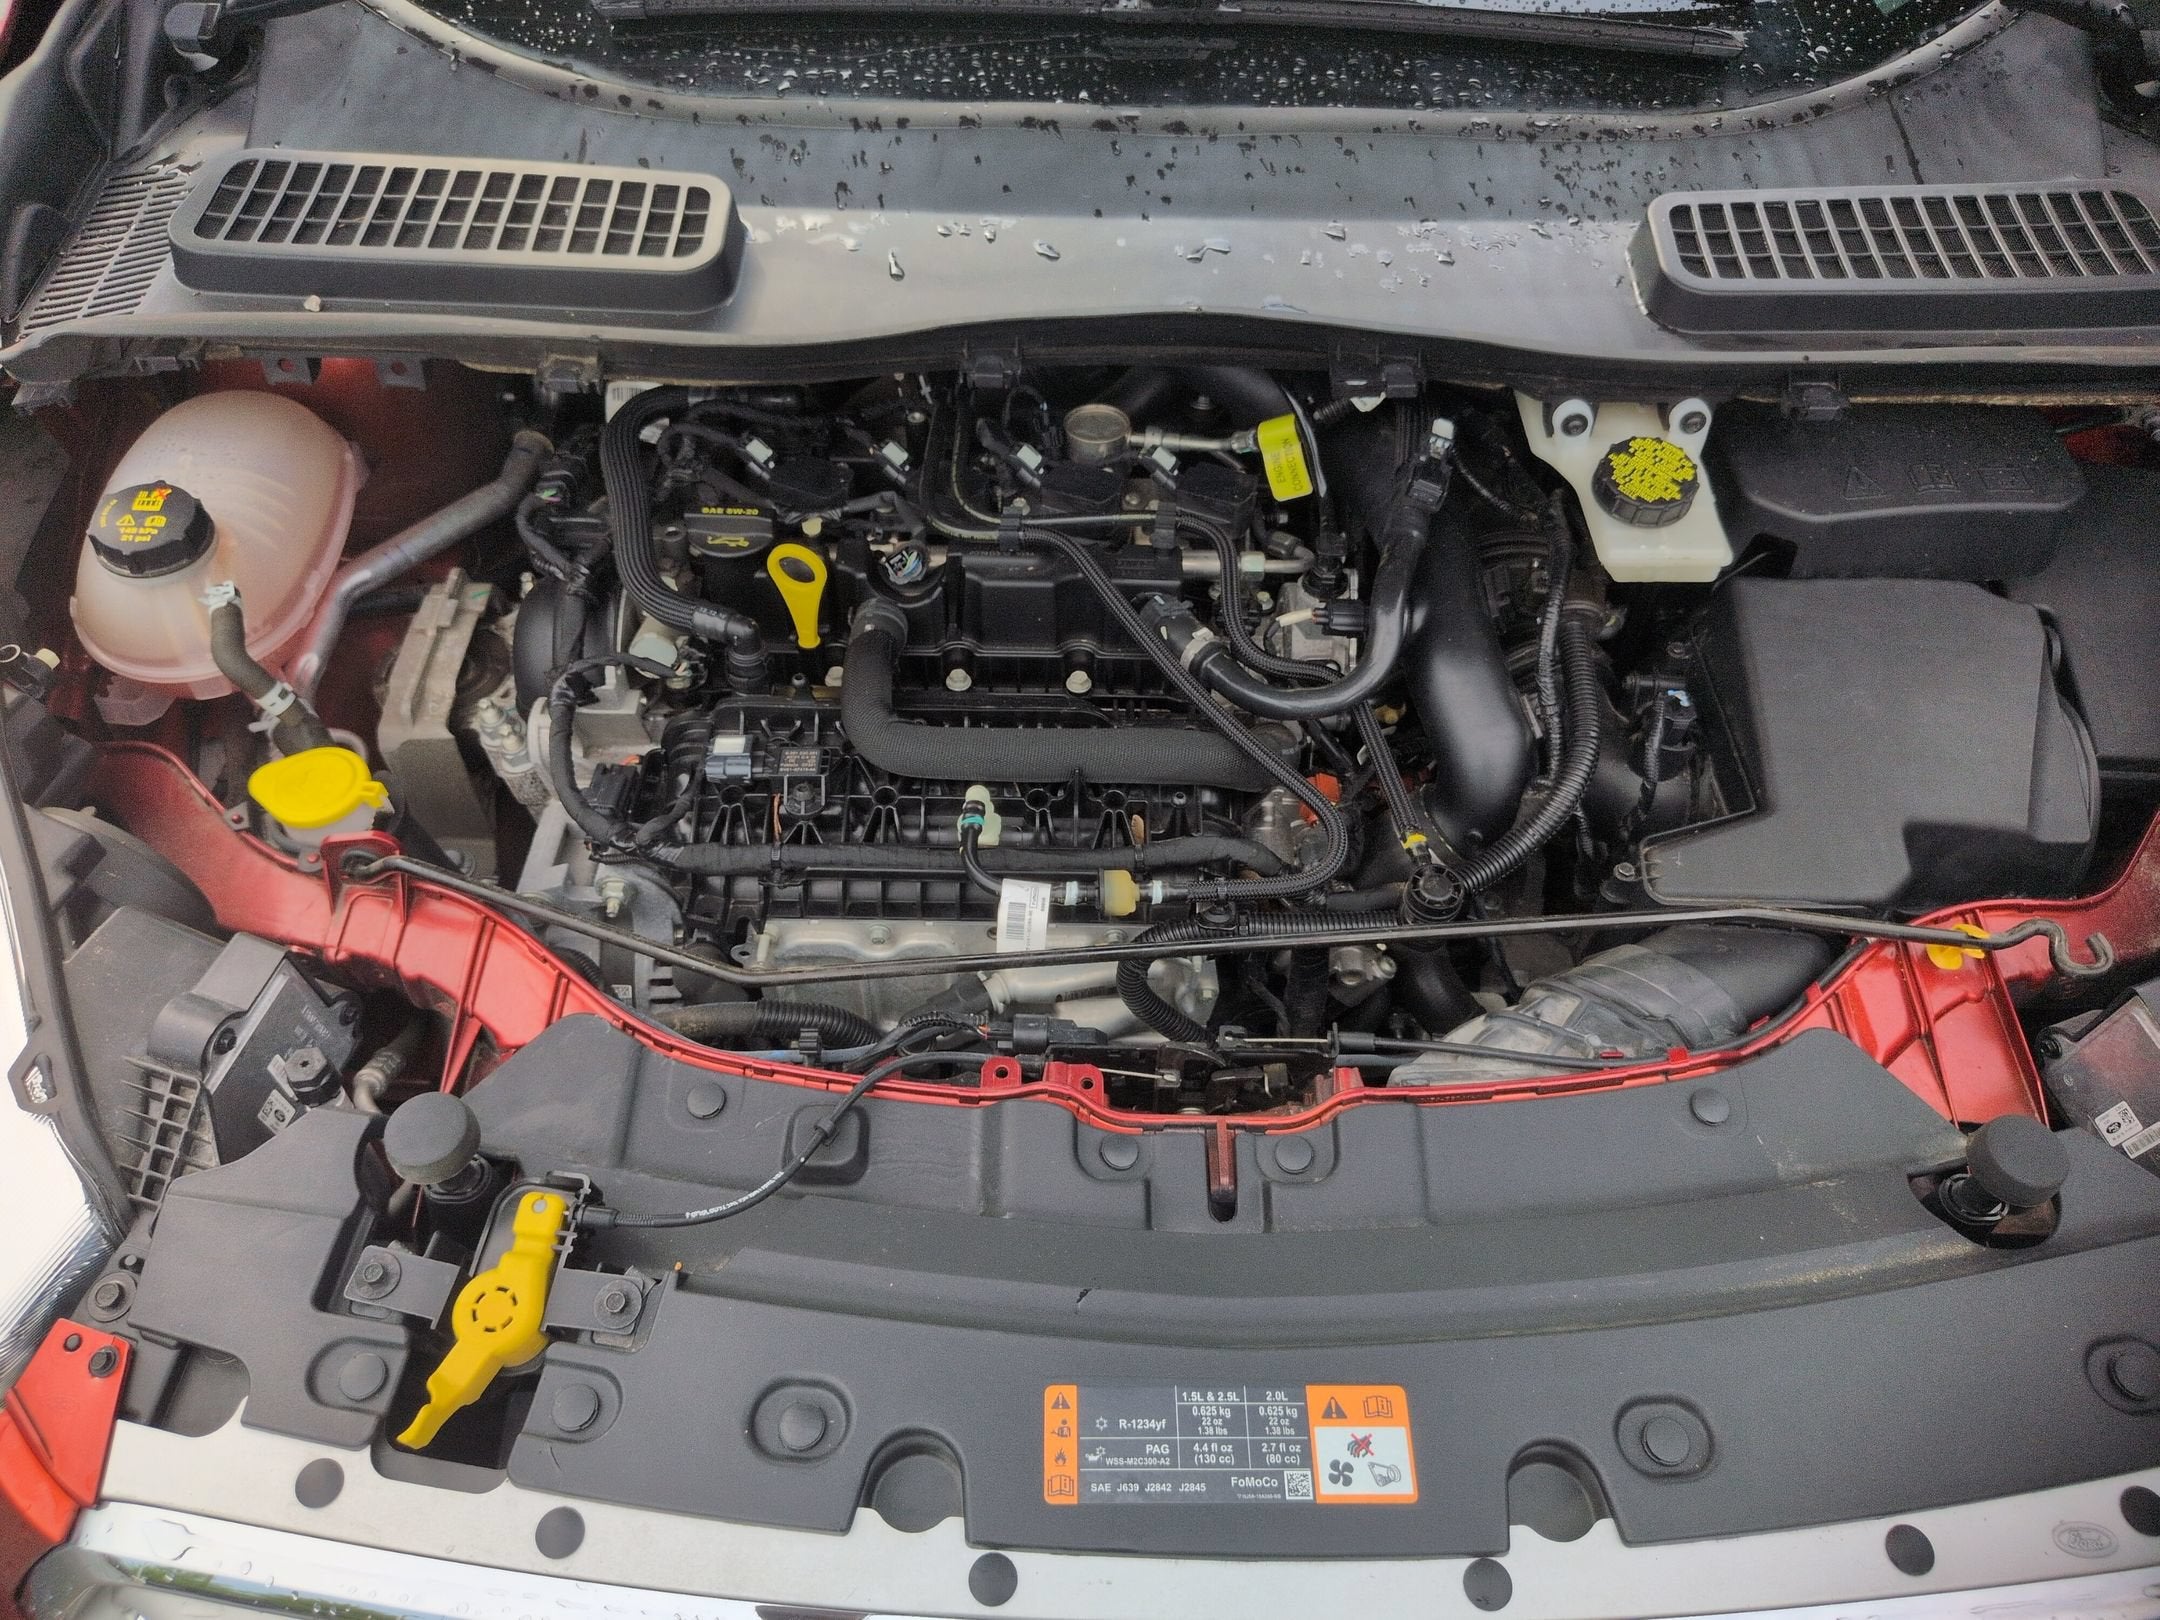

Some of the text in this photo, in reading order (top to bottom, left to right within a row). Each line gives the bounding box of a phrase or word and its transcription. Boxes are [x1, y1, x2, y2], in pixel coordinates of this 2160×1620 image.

[1271, 451, 1287, 484] ENGINE
[1281, 438, 1304, 491] CONNECTION
[1182, 1391, 1240, 1402] 1.5L & 2.5L
[1265, 1391, 1288, 1401] 2.0L
[1192, 1406, 1231, 1418] 0.625 kg
[1259, 1406, 1298, 1418] 0.625 kg
[1118, 1418, 1167, 1431] R-1234yf
[1201, 1417, 1223, 1426] 22 oz
[1269, 1417, 1290, 1426] 22 oz
[1198, 1426, 1228, 1435] 1.38 lbs
[1265, 1426, 1295, 1435] 1.38 lbs
[1145, 1444, 1170, 1455] PAG
[1193, 1442, 1233, 1452] 4.4 fl oz
[1261, 1442, 1301, 1452] 2.7 fl oz
[1105, 1457, 1171, 1466] WSS-M2C300-A2
[1194, 1454, 1235, 1465] (130 cc)
[1265, 1454, 1301, 1465] (80 cc)
[1090, 1483, 1206, 1492] SAE J639 J2842 J2845
[1230, 1477, 1278, 1488] FoMoCo
